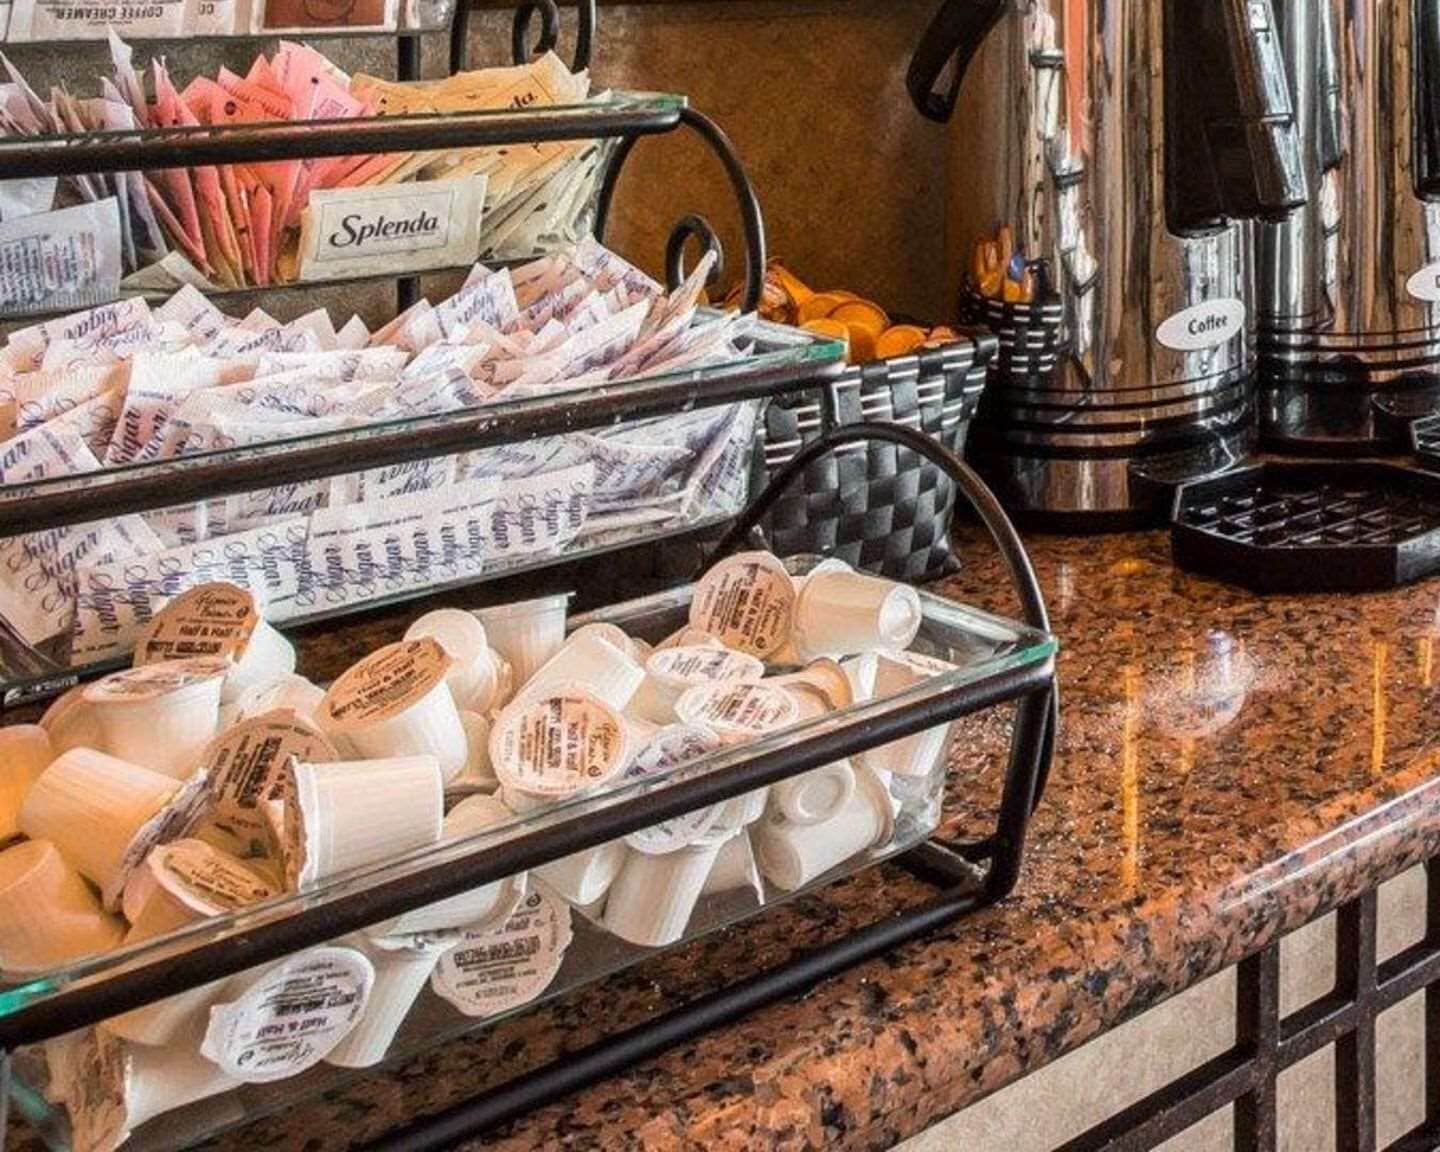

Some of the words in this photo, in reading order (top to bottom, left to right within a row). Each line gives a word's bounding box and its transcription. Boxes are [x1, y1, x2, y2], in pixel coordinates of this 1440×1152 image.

[121, 5, 164, 18] COFFEE
[329, 210, 438, 248] Splenda
[1188, 313, 1228, 335] Coffee
[25, 532, 98, 592] Sugar
